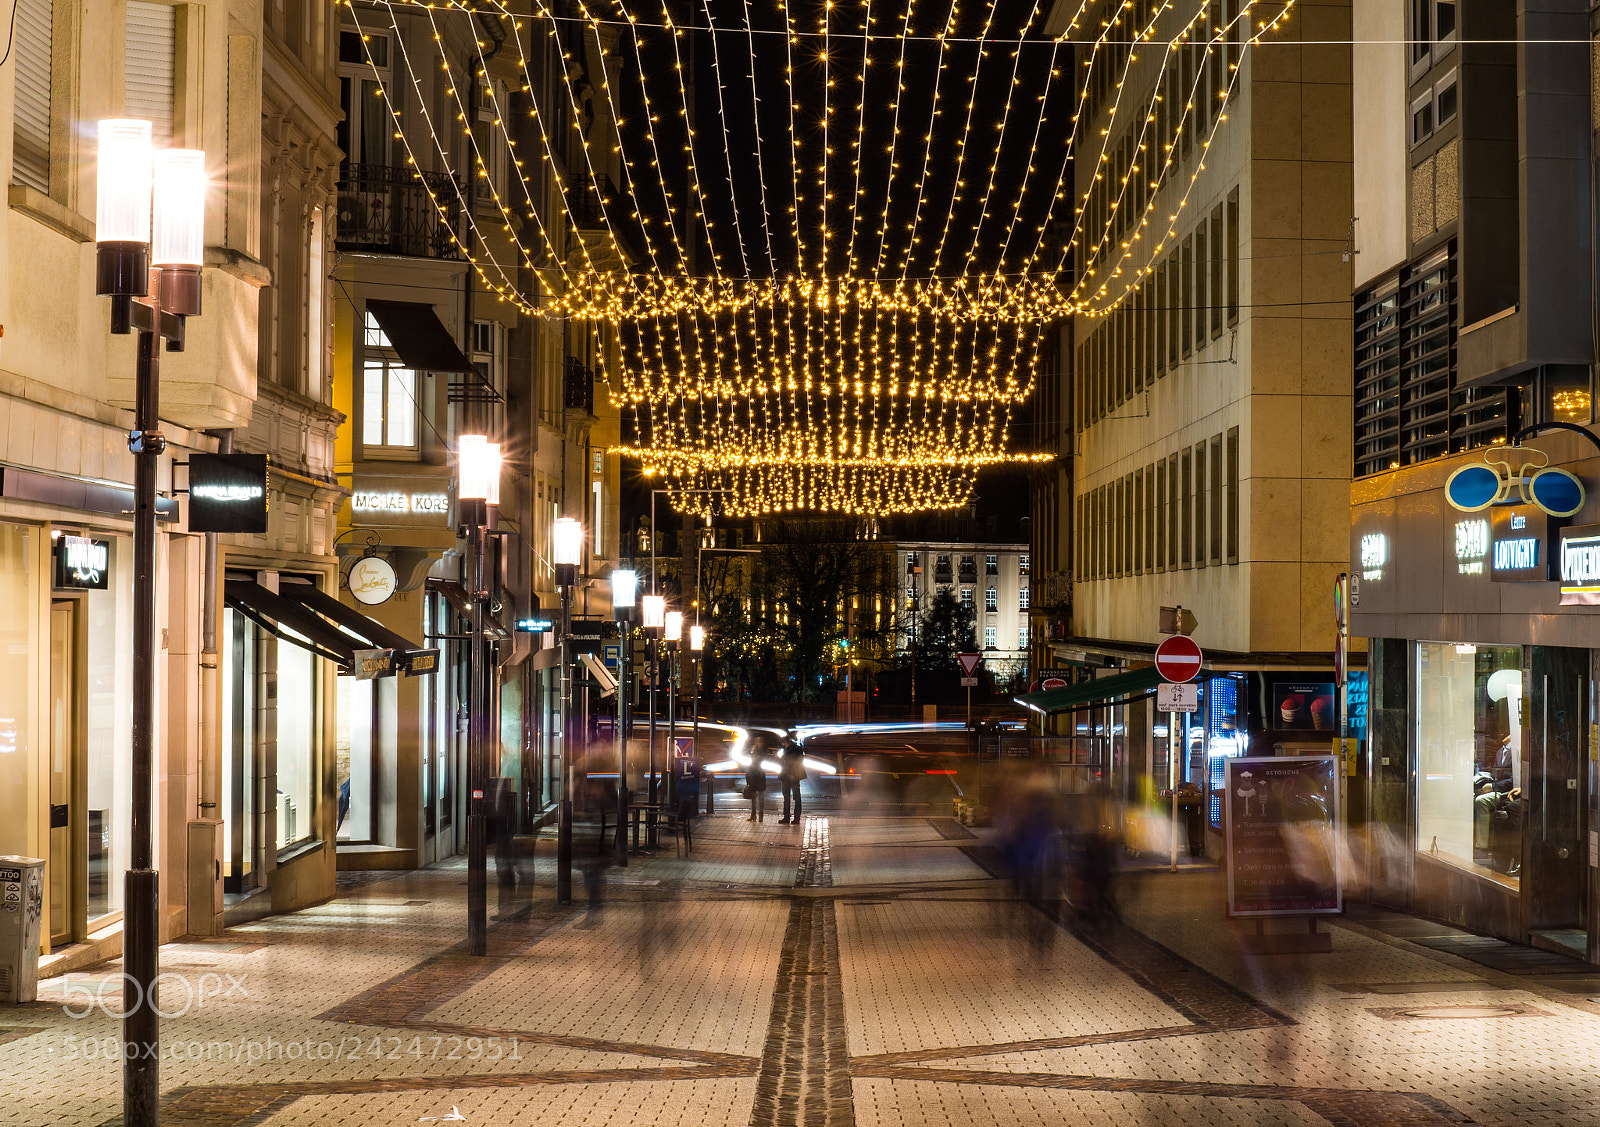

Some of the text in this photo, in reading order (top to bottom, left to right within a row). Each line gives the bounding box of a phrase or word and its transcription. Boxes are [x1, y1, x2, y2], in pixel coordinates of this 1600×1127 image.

[415, 497, 449, 511] KORS
[1494, 538, 1536, 569] LOUVIGNY
[0, 871, 20, 879] TOO
